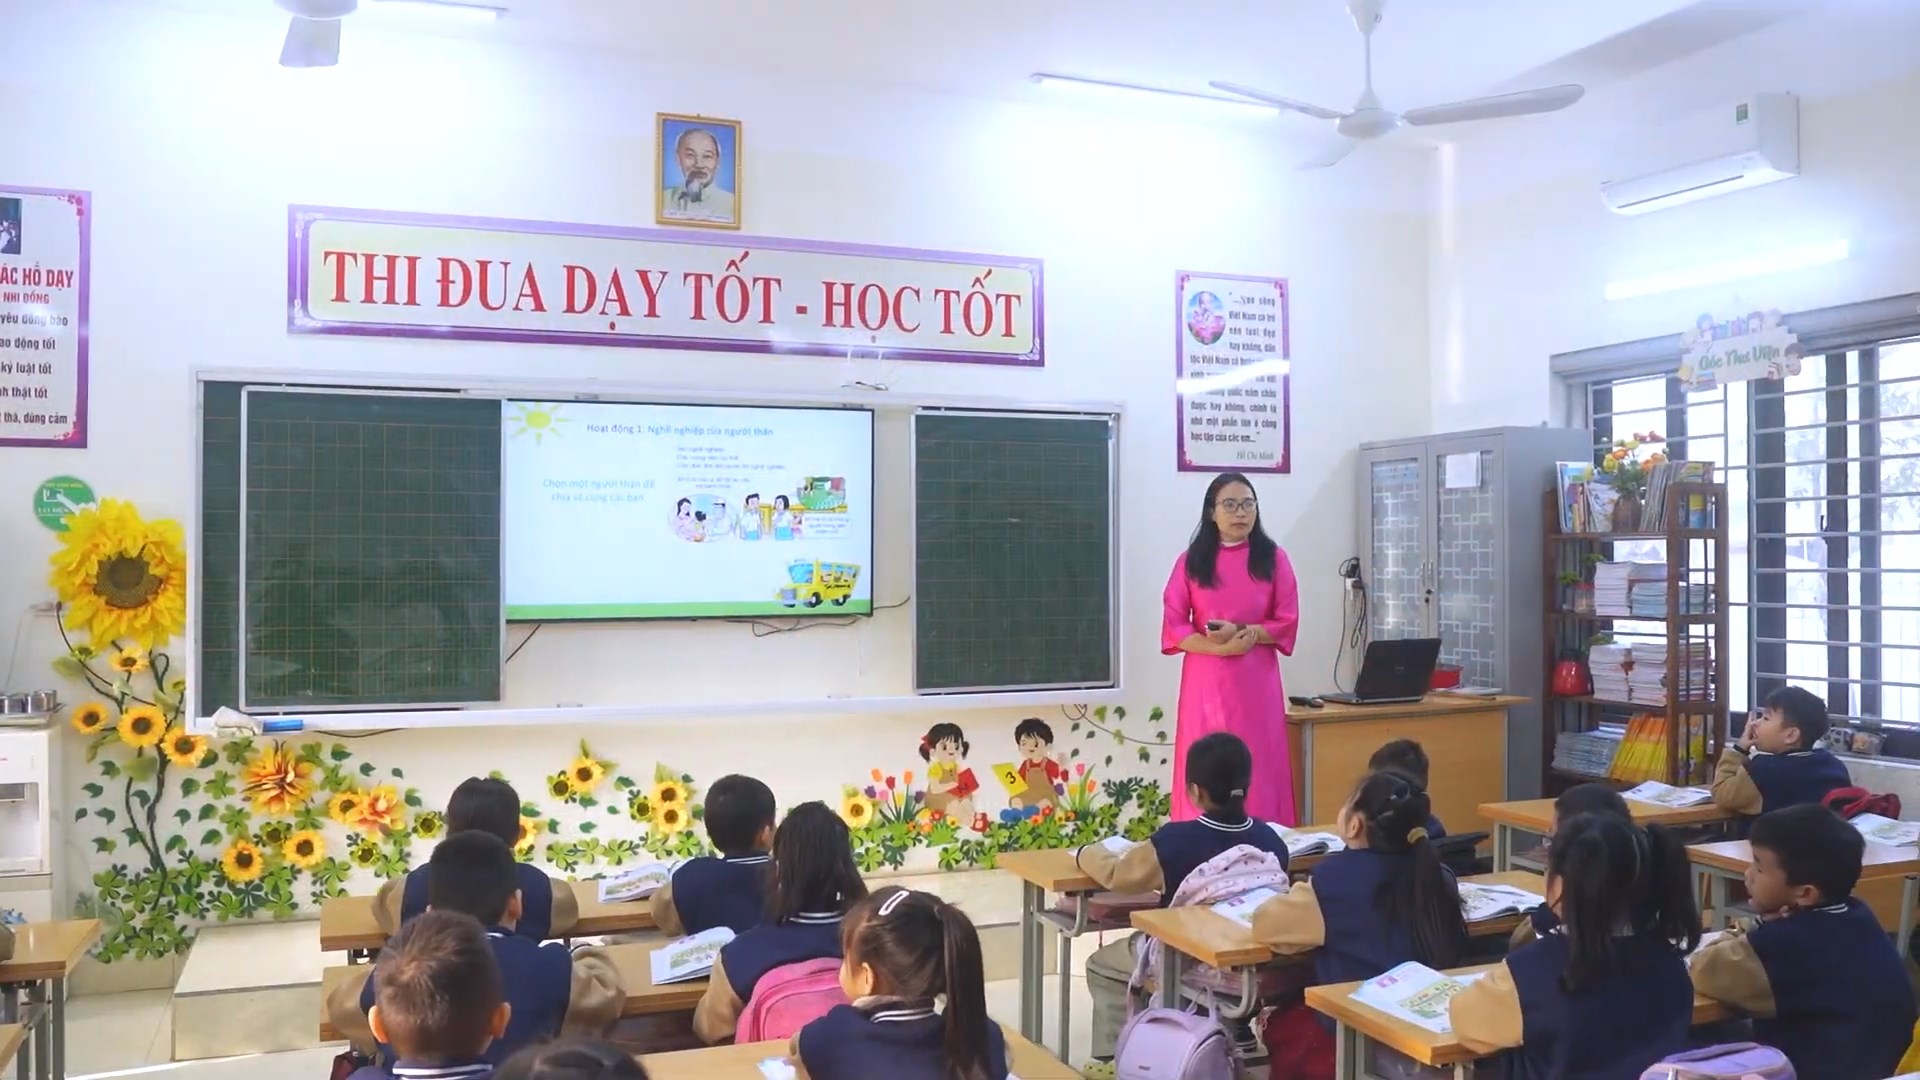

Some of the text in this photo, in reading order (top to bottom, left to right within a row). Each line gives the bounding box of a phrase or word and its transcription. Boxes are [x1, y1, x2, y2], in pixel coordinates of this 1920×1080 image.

[22, 261, 41, 287] HỒ
[46, 269, 74, 291] DẠY
[3, 291, 20, 303] NHI
[323, 250, 1022, 344] THI ĐUA DẠY TỐT - HỌC TỐT
[14, 337, 39, 351] động
[42, 337, 56, 350] tốt
[16, 361, 35, 376] luật
[39, 361, 52, 374] tốt
[12, 386, 31, 400] thật
[34, 385, 48, 399] tốt
[48, 411, 68, 424] cảm
[587, 424, 609, 433] Hoạt
[611, 423, 634, 435] động
[1005, 771, 1017, 785] 3
